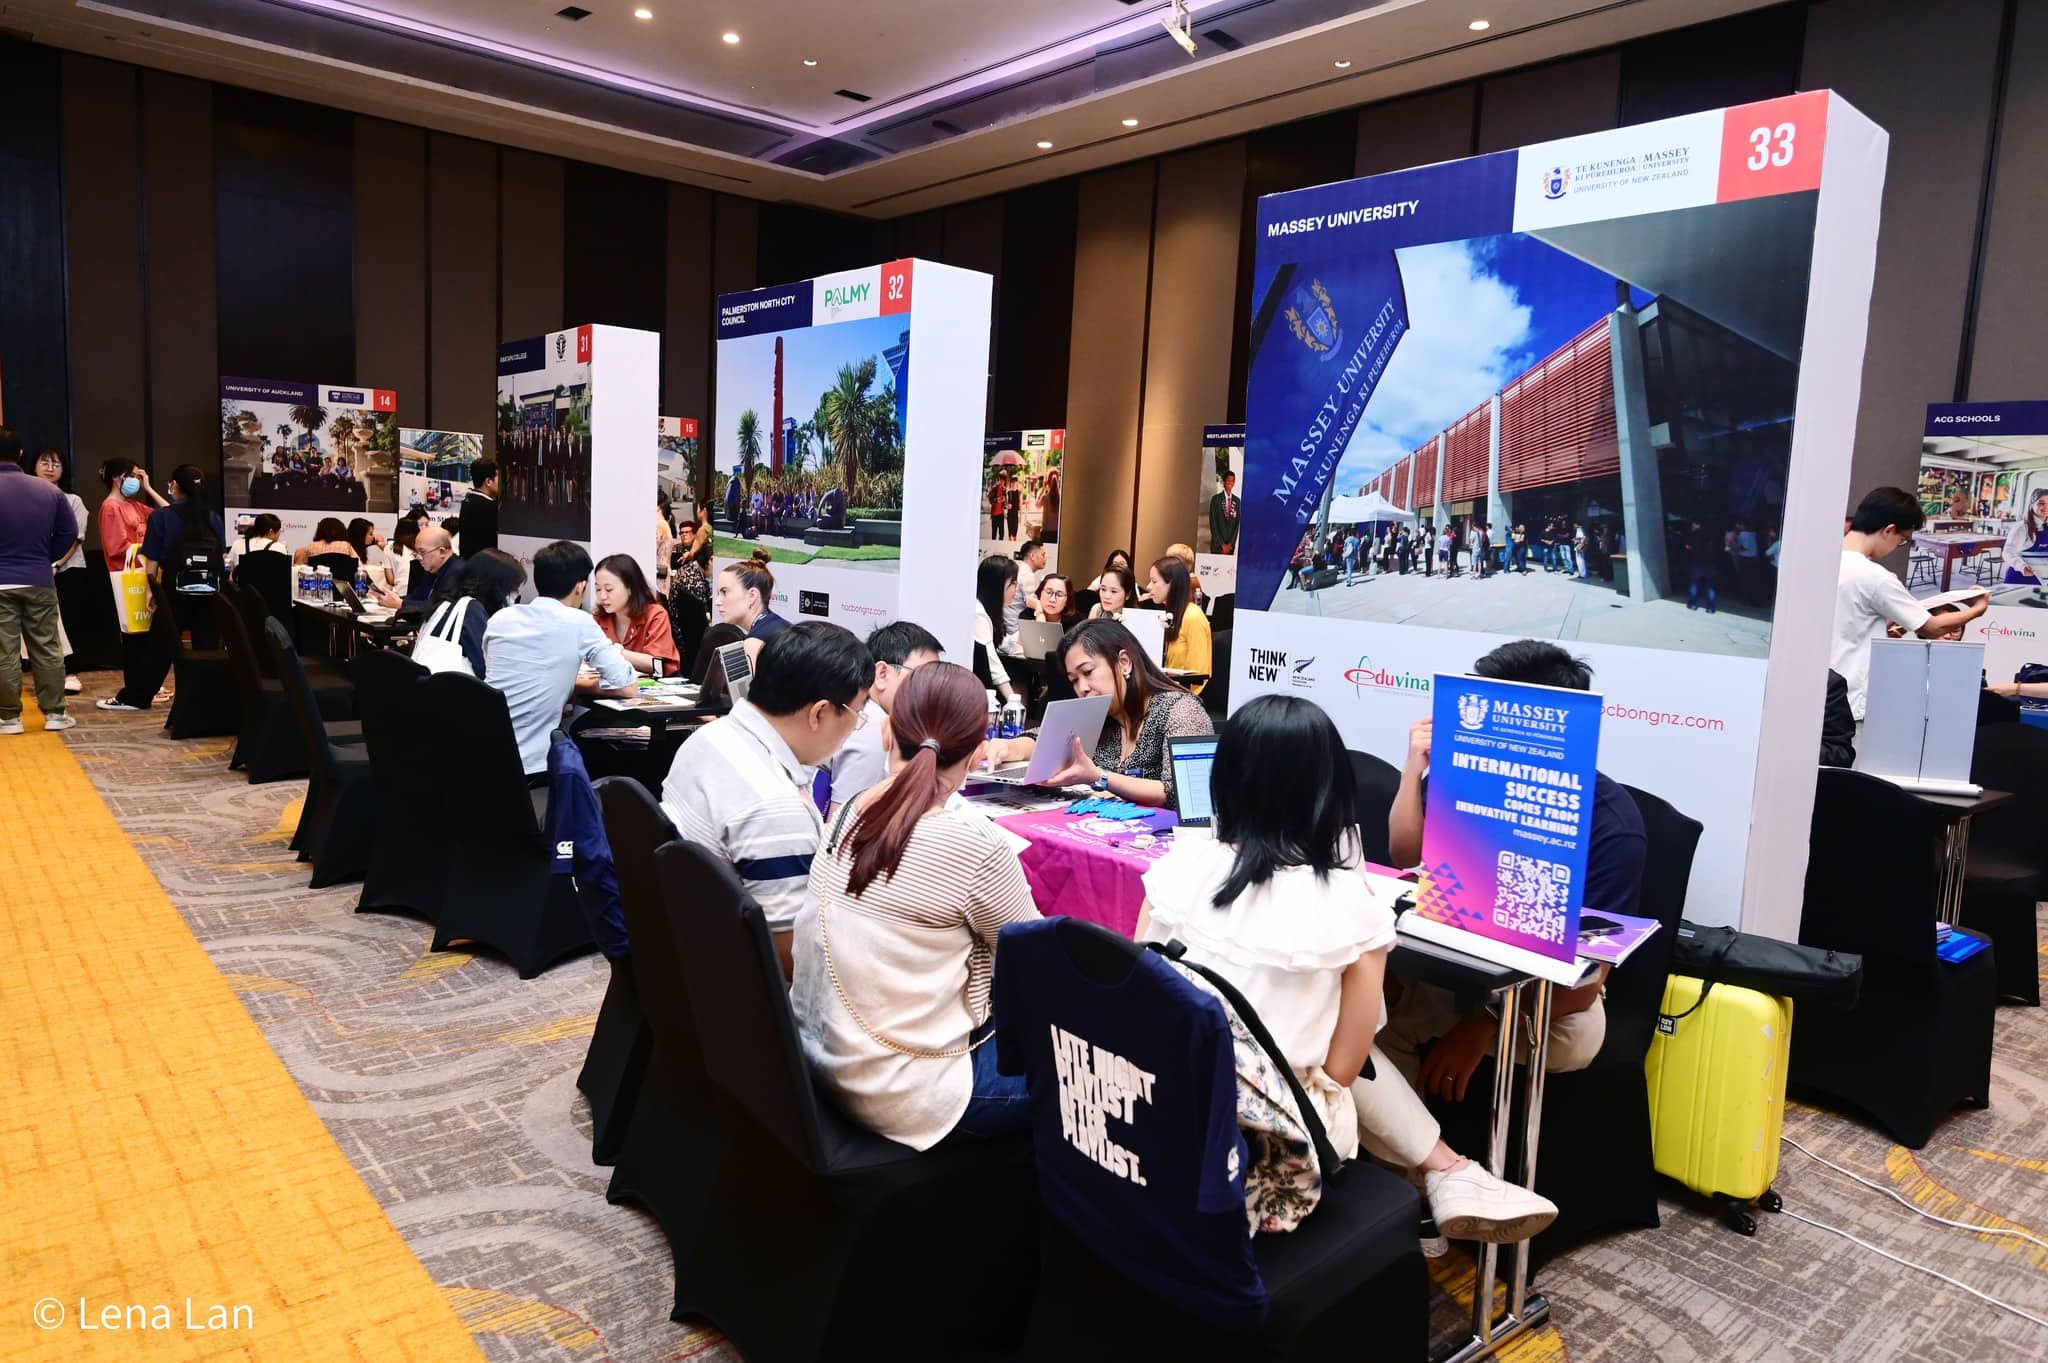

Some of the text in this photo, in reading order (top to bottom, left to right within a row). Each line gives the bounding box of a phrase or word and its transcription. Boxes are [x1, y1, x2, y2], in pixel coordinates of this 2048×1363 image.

[1643, 147, 1690, 163] MASSEY
[1747, 122, 1796, 171] 33
[1575, 156, 1636, 174] TE KUNENGA
[1643, 156, 1690, 170] UNIVERSITY
[1573, 168, 1689, 194] UNIVERSITY OF NEW ZEALAND
[1575, 173, 1584, 181] KI
[1267, 200, 1420, 237] MASSEY UNIVERSITY
[824, 282, 871, 308] PALMY
[888, 274, 904, 300] 32
[721, 294, 796, 316] PALMERSTON NORTH CITY
[721, 314, 746, 326] COUNCIL
[225, 385, 261, 393] UNIVERSITY
[271, 389, 304, 397] AUCKLAND
[381, 395, 390, 406] 14
[1272, 297, 1396, 506] MASSEY UNIVERSITY
[1295, 318, 1404, 524] TE KUNENGA KI PUREHUROA
[1955, 414, 2001, 423] SCHOOLS
[1250, 647, 1287, 667] THINK
[1249, 665, 1277, 683] NEW
[1492, 700, 1569, 723] MASSEY
[1601, 704, 1724, 731] cbongnz.com
[1492, 714, 1567, 733] UNIVERSITY
[1454, 734, 1496, 748] UNIVERSITY
[1496, 741, 1507, 749] OF
[1509, 743, 1527, 753] NEW
[1528, 745, 1565, 760] ZEALAND
[1452, 751, 1582, 791] INTERNATIONAL
[1505, 781, 1581, 810] SUCCESS
[1455, 800, 1578, 836] INNOVATIVE LEARNING
[1503, 798, 1580, 824] COMES FROM
[1513, 828, 1577, 849] massey.ac.nz
